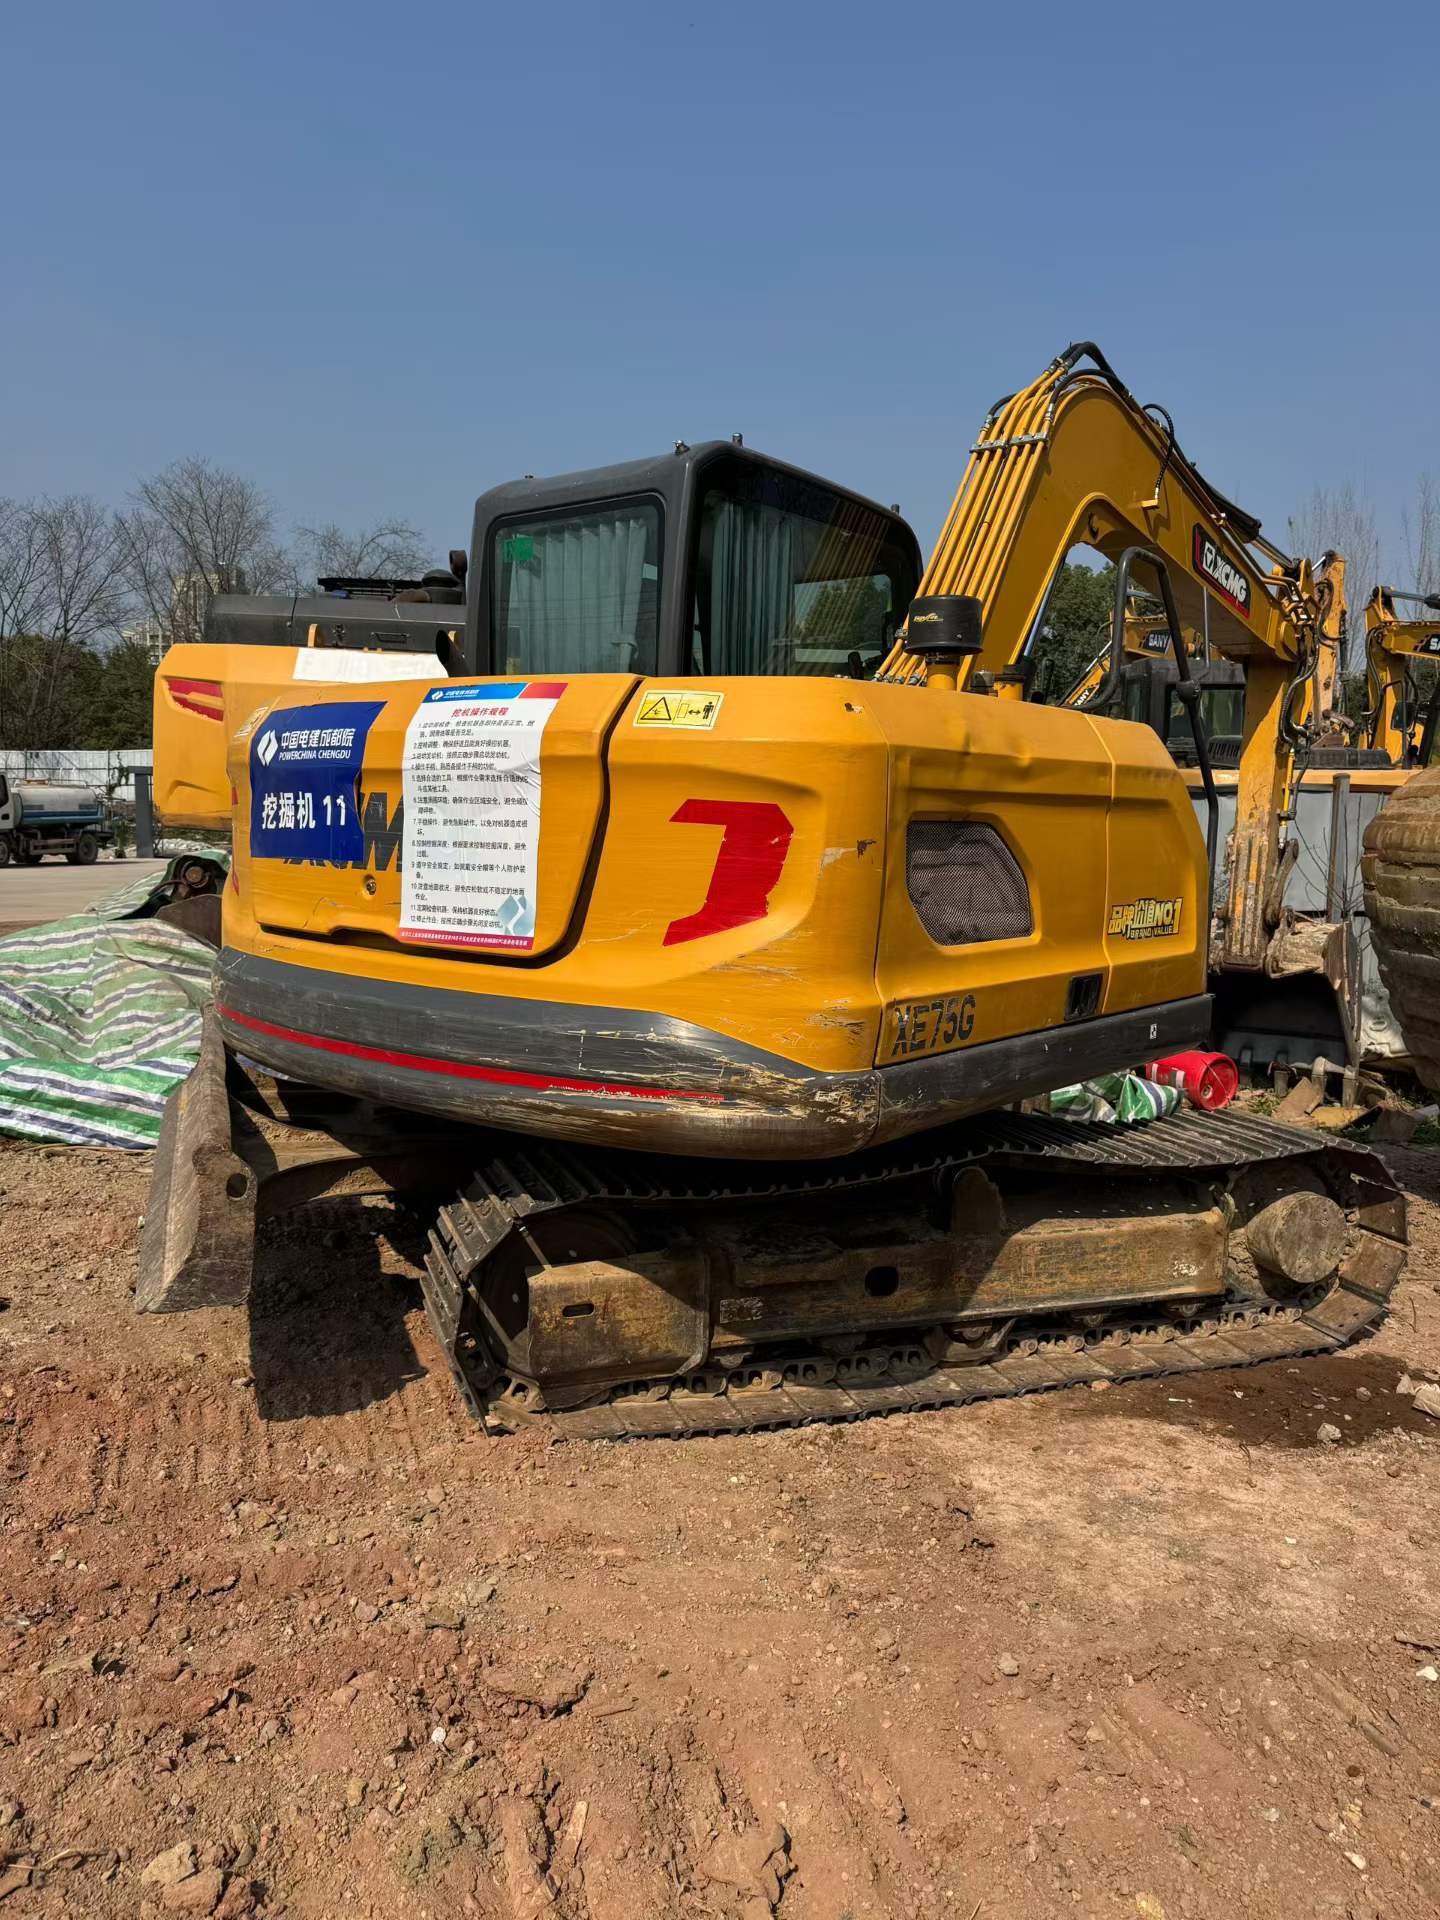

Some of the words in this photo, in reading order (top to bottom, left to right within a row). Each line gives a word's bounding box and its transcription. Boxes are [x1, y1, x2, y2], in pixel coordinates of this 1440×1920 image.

[1212, 555, 1247, 602] XCMG
[1148, 633, 1169, 648] SANY
[451, 706, 510, 718] 挖机操作规程
[281, 728, 356, 749] 中国电建成都院
[279, 750, 317, 761] POWERCHINA
[318, 750, 351, 759] CHENGDU
[262, 791, 316, 829] 挖掘机
[323, 795, 346, 826] 11
[891, 995, 976, 1056] XE75G
